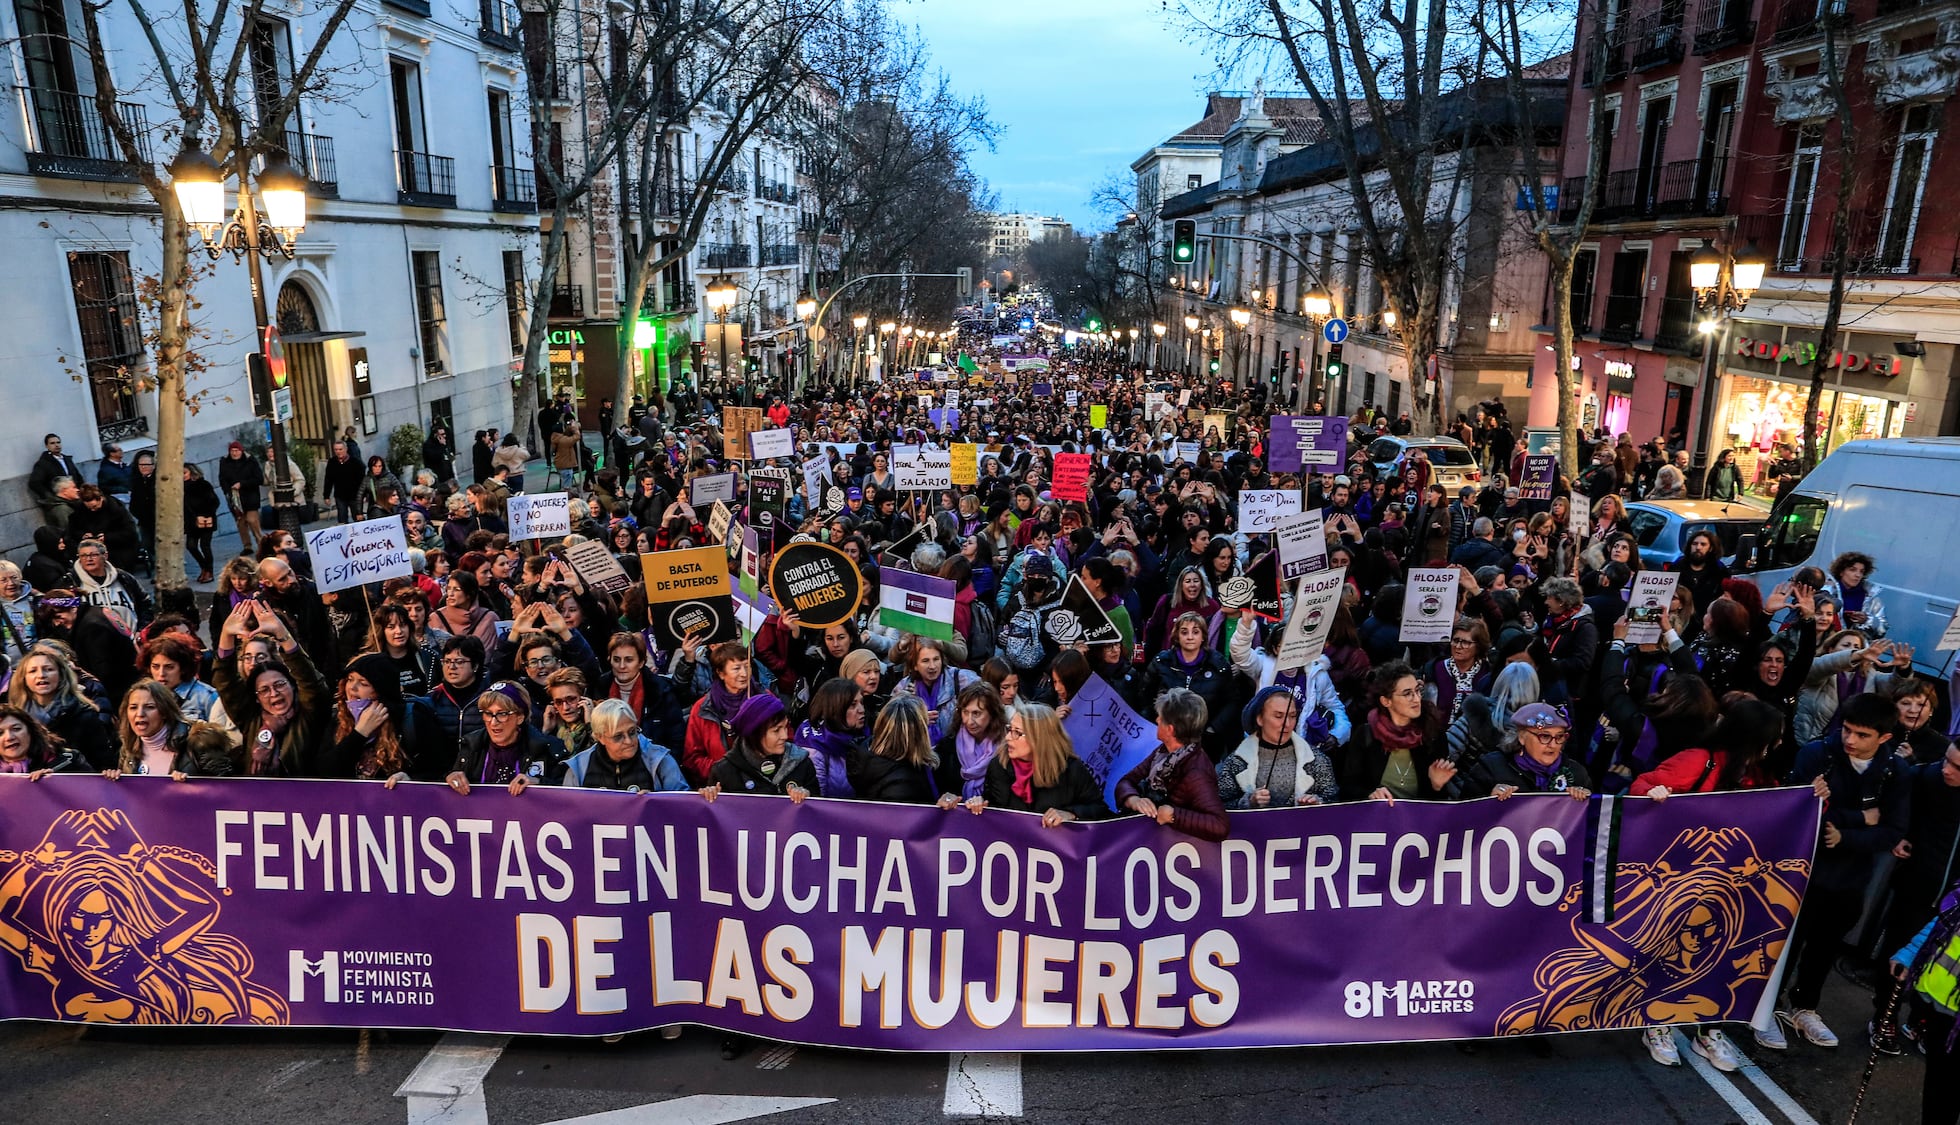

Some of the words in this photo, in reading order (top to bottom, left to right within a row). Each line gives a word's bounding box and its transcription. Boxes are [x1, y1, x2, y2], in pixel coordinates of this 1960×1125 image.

[901, 478, 948, 487] SALARIO
[757, 487, 777, 496] PAÍS
[1243, 493, 1256, 504] YO
[1260, 494, 1275, 502] SOY
[531, 497, 567, 509] MUJERES
[526, 510, 541, 521] NO
[526, 523, 567, 534] BORRARAN
[309, 531, 342, 555] TECHO
[325, 552, 409, 585] ESTRUCTURAL
[669, 563, 702, 575] BASTA
[784, 561, 821, 583] CONTRA
[820, 558, 835, 570] EL
[657, 581, 671, 590] DE
[673, 576, 719, 589] PUTEROS
[788, 572, 830, 596] BORRADO
[1304, 577, 1340, 594] #LOASP
[1414, 574, 1454, 582] #LOASP
[1641, 577, 1674, 586] #LOASP
[793, 583, 847, 611] MUJERES
[1082, 623, 1112, 641] FeMeS
[1108, 698, 1120, 718] TU
[1119, 713, 1144, 739] ERES
[215, 810, 575, 903] FEMINISTAS
[593, 824, 678, 904] EN
[698, 827, 916, 914] LUCHA
[938, 838, 1064, 927] POR
[1084, 840, 1201, 931] LOS
[1220, 826, 1567, 917] DERECHOS
[343, 950, 433, 966] MOVIMIENTO
[343, 969, 433, 988] FEMINISTA
[516, 911, 627, 1015] DE
[648, 911, 815, 1022] LAS
[840, 925, 1241, 1030] MUJERES
[344, 990, 365, 1003] DE
[371, 991, 435, 1005] MADRID
